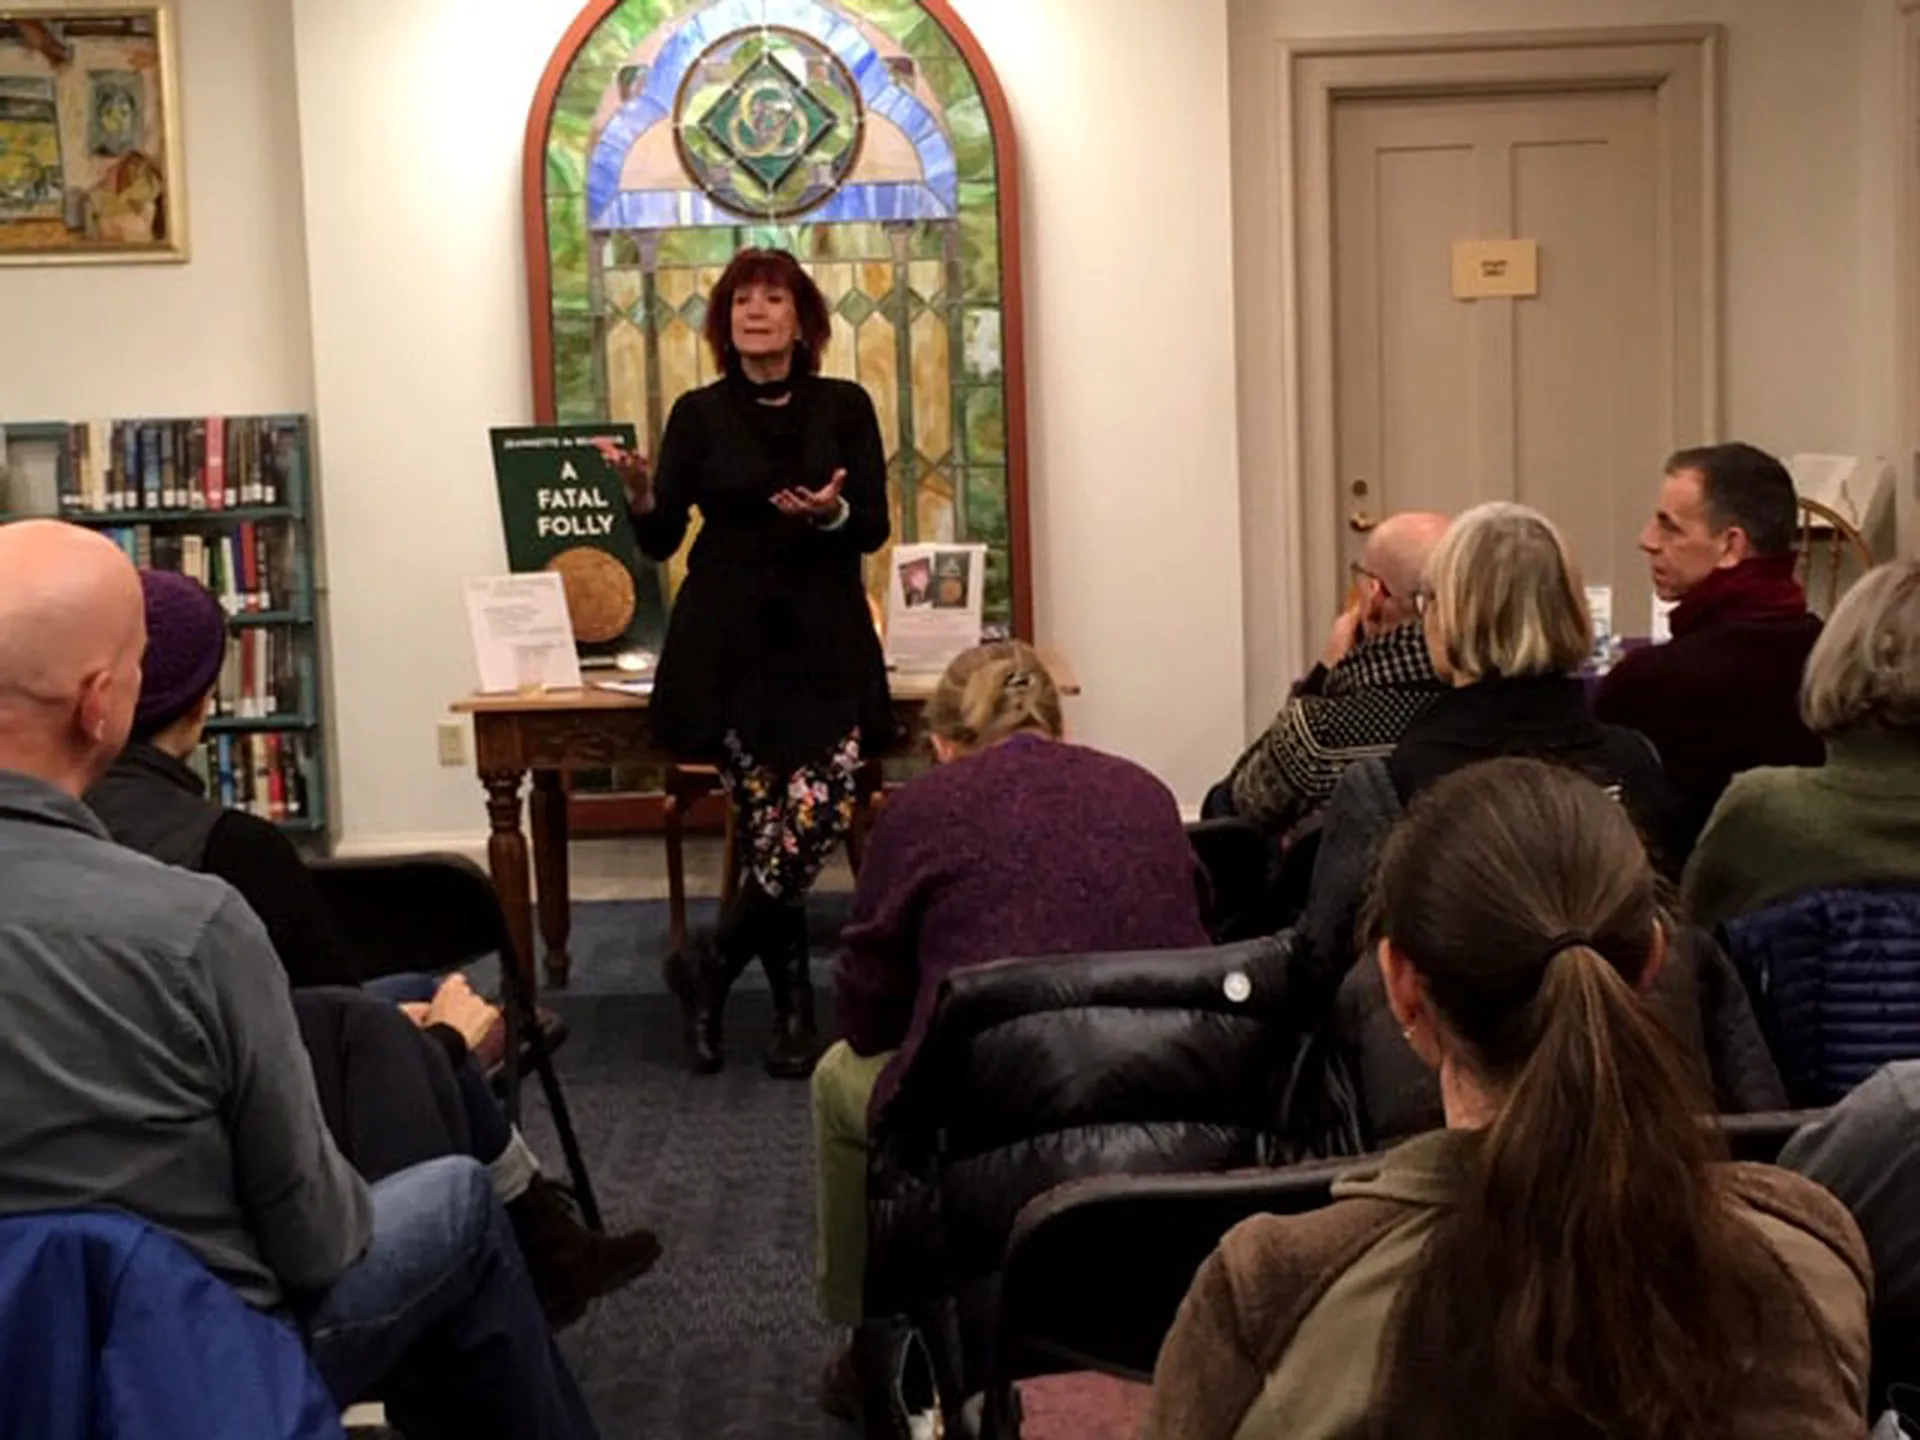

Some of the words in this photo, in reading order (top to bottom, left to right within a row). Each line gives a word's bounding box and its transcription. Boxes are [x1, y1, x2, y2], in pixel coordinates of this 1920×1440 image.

[561, 461, 578, 481] A
[537, 488, 609, 510] FATAL
[537, 514, 614, 538] FOLLY
